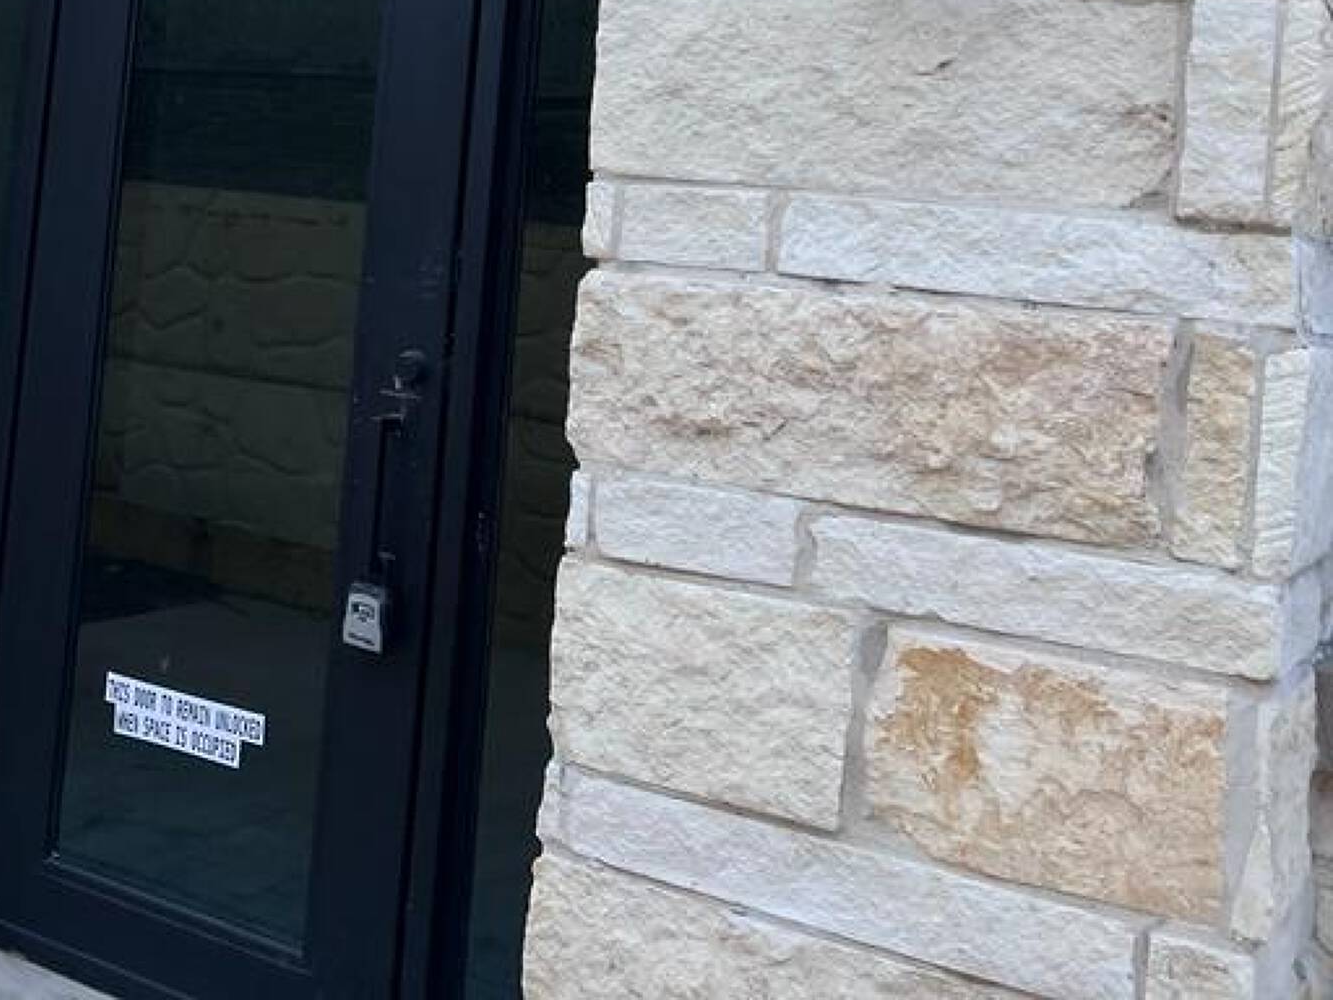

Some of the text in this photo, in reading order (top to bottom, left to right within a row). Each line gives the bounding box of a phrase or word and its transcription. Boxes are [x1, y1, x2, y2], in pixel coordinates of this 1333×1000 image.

[108, 679, 261, 741] THIS DOOR TO REMAIN UNLOCKED
[118, 711, 235, 764] WHEN SPACE IS OCCUPIED
